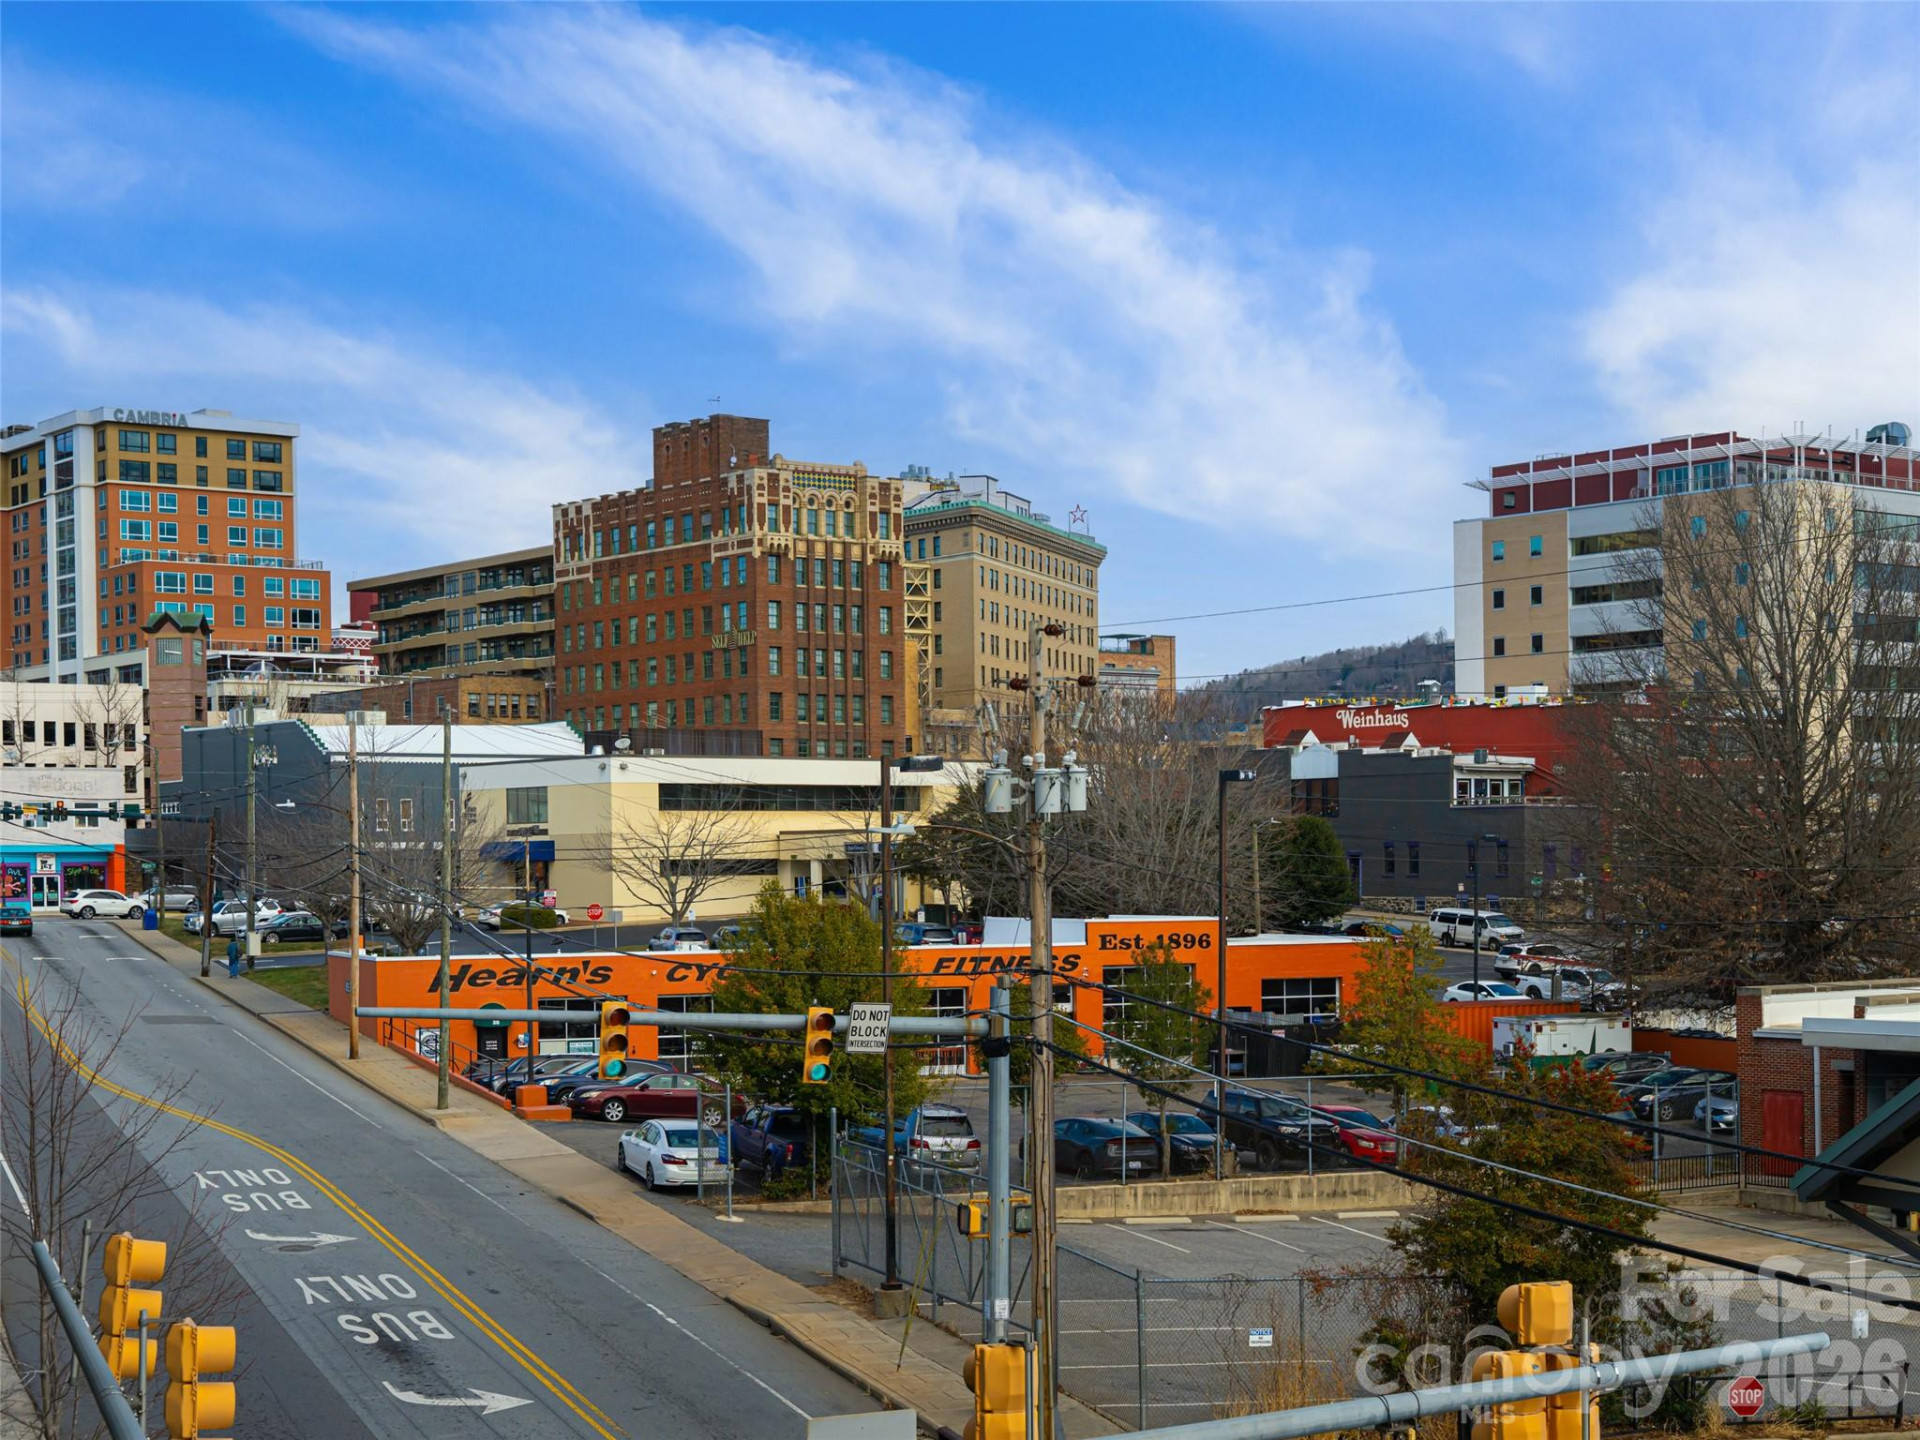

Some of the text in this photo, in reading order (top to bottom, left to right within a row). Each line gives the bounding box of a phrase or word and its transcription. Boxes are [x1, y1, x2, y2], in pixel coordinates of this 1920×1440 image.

[1336, 709, 1409, 729] Weinhaus
[1156, 933, 1211, 950] 1896
[427, 960, 614, 993] Hearn's
[853, 1010, 889, 1021] DO NOT
[850, 1026, 887, 1037] BLOCK
[194, 1168, 292, 1189] ONLY
[222, 1190, 312, 1212] BUS
[294, 1273, 417, 1305] ONLY
[337, 1310, 456, 1344] BUS
[1730, 1389, 1762, 1404] STOP
